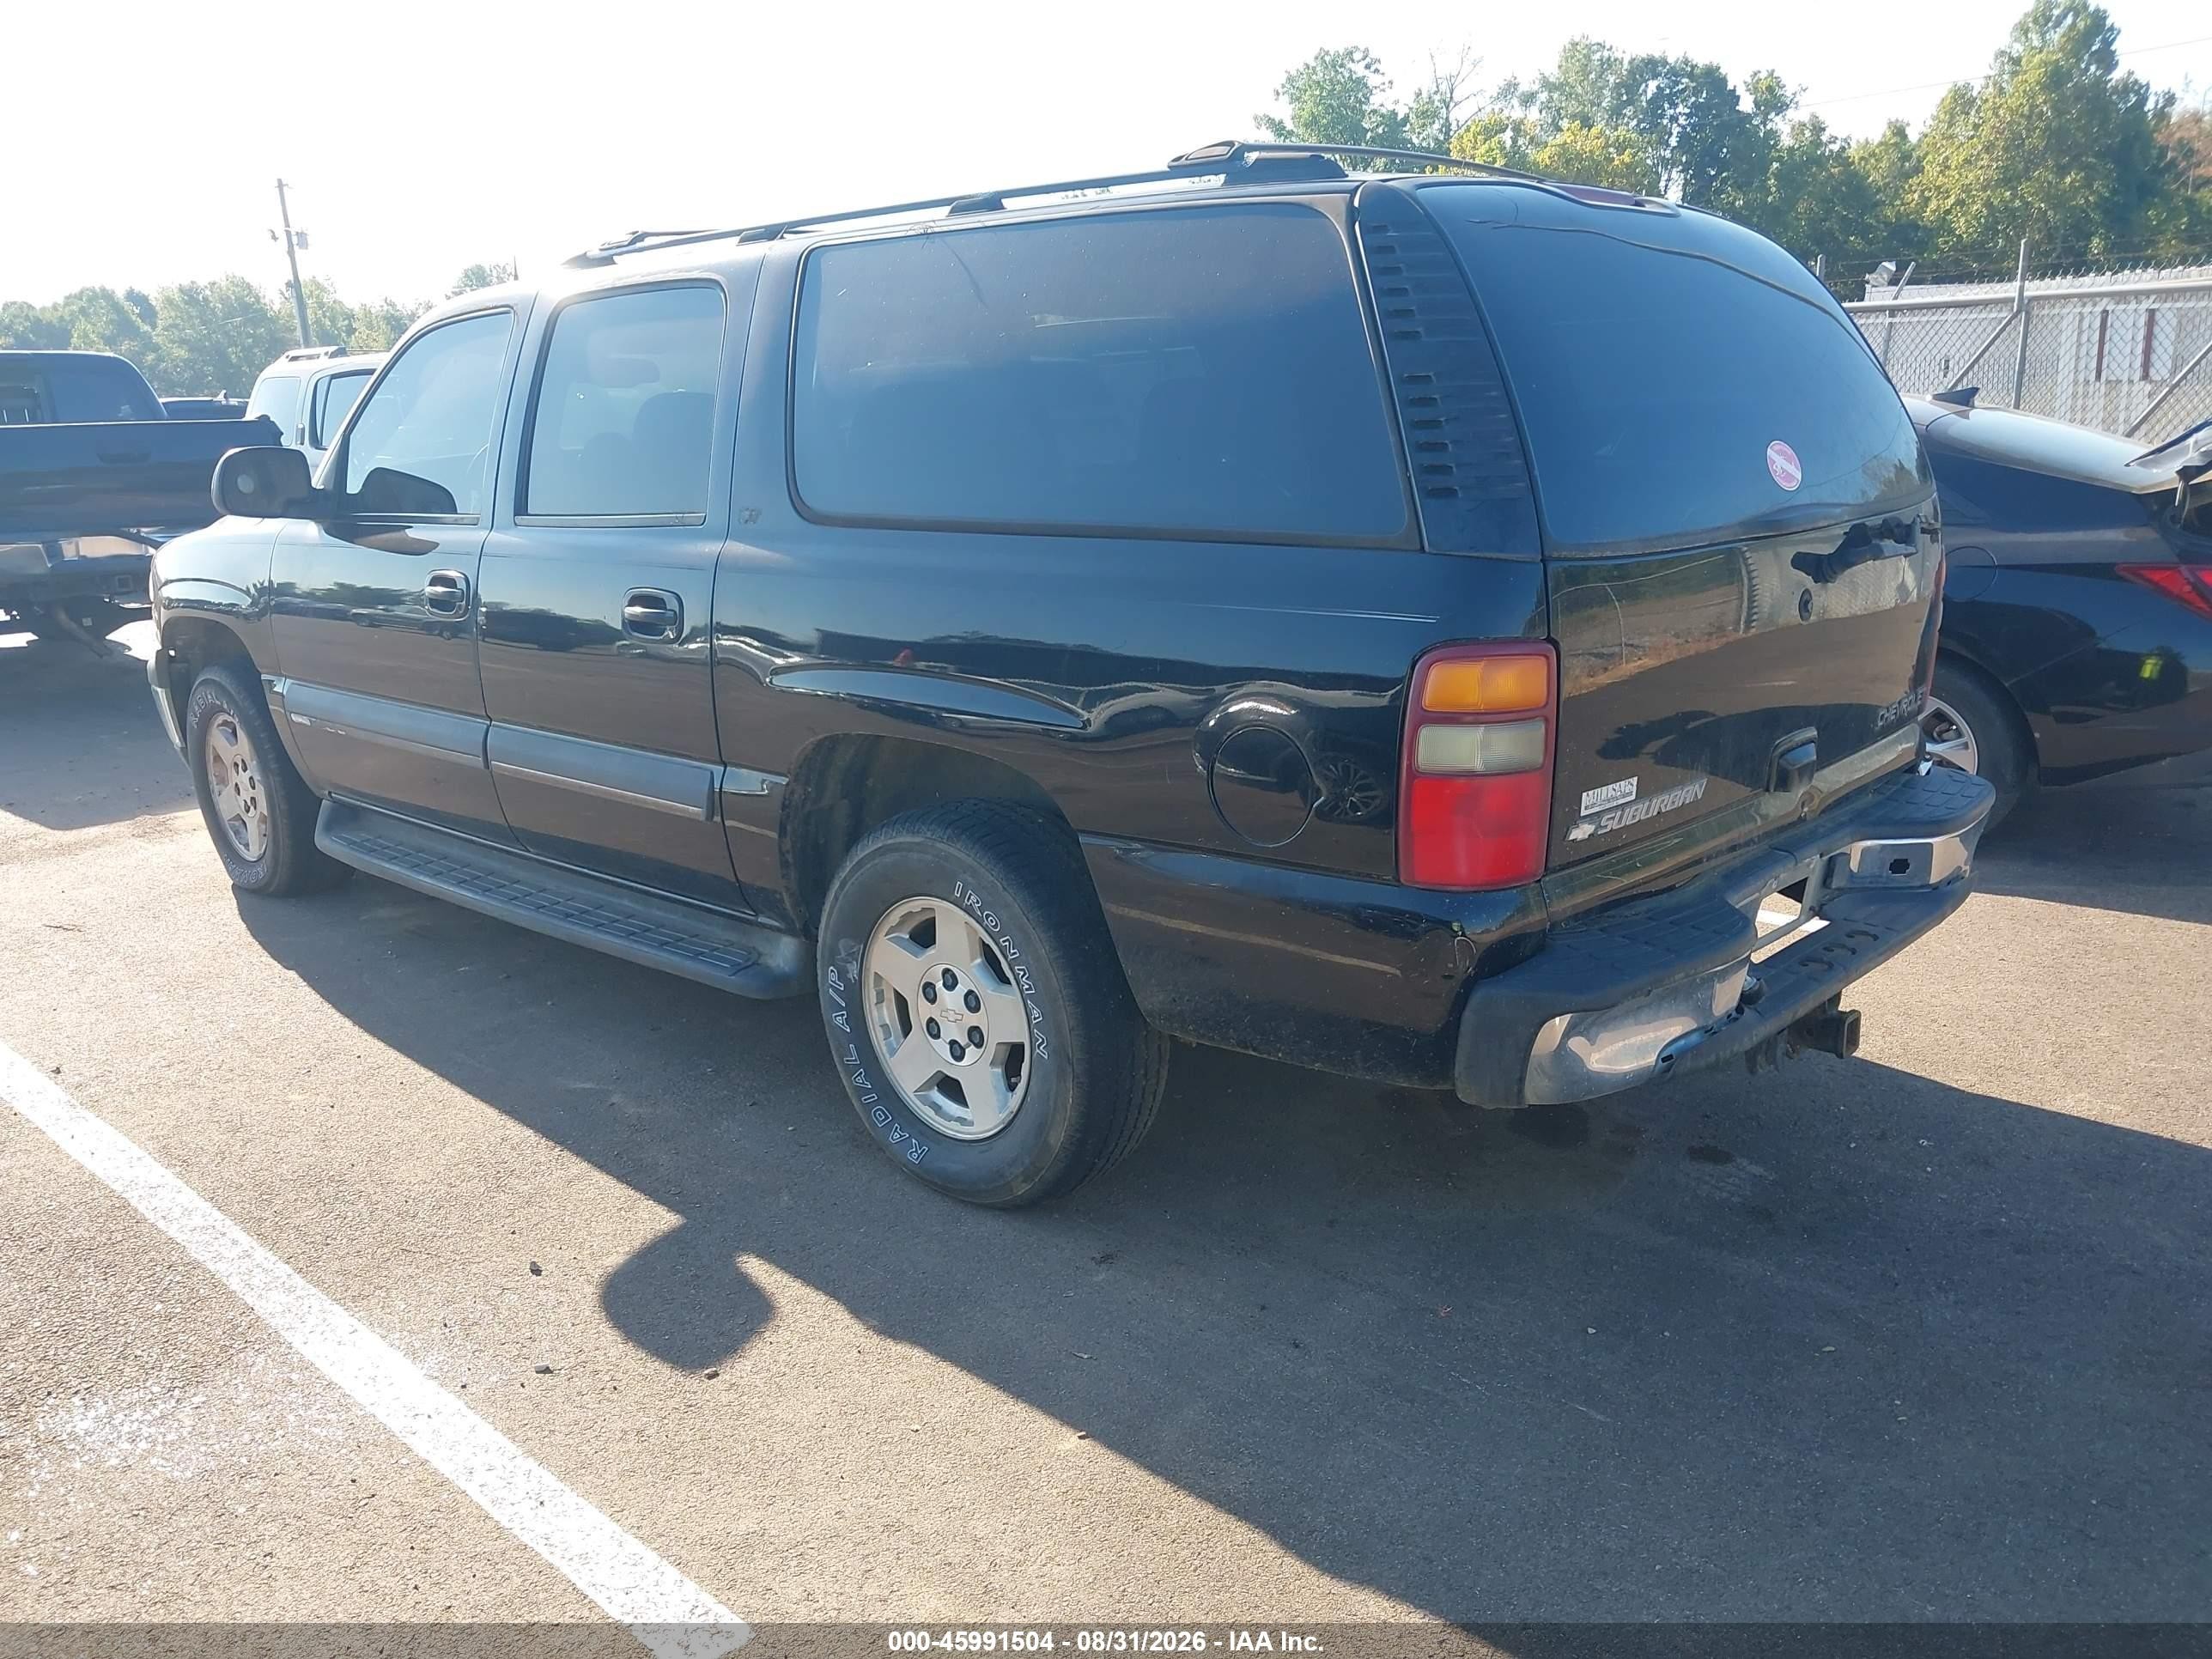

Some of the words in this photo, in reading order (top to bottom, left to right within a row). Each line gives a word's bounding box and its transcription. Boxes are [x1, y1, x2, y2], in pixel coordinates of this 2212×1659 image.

[1875, 686, 1925, 730] CHEVROLE
[1597, 778, 1708, 836] SUBURBAN
[828, 965, 852, 1033] A/P
[954, 880, 1049, 1060] IRONMAN
[843, 1043, 929, 1165] RADIAL
